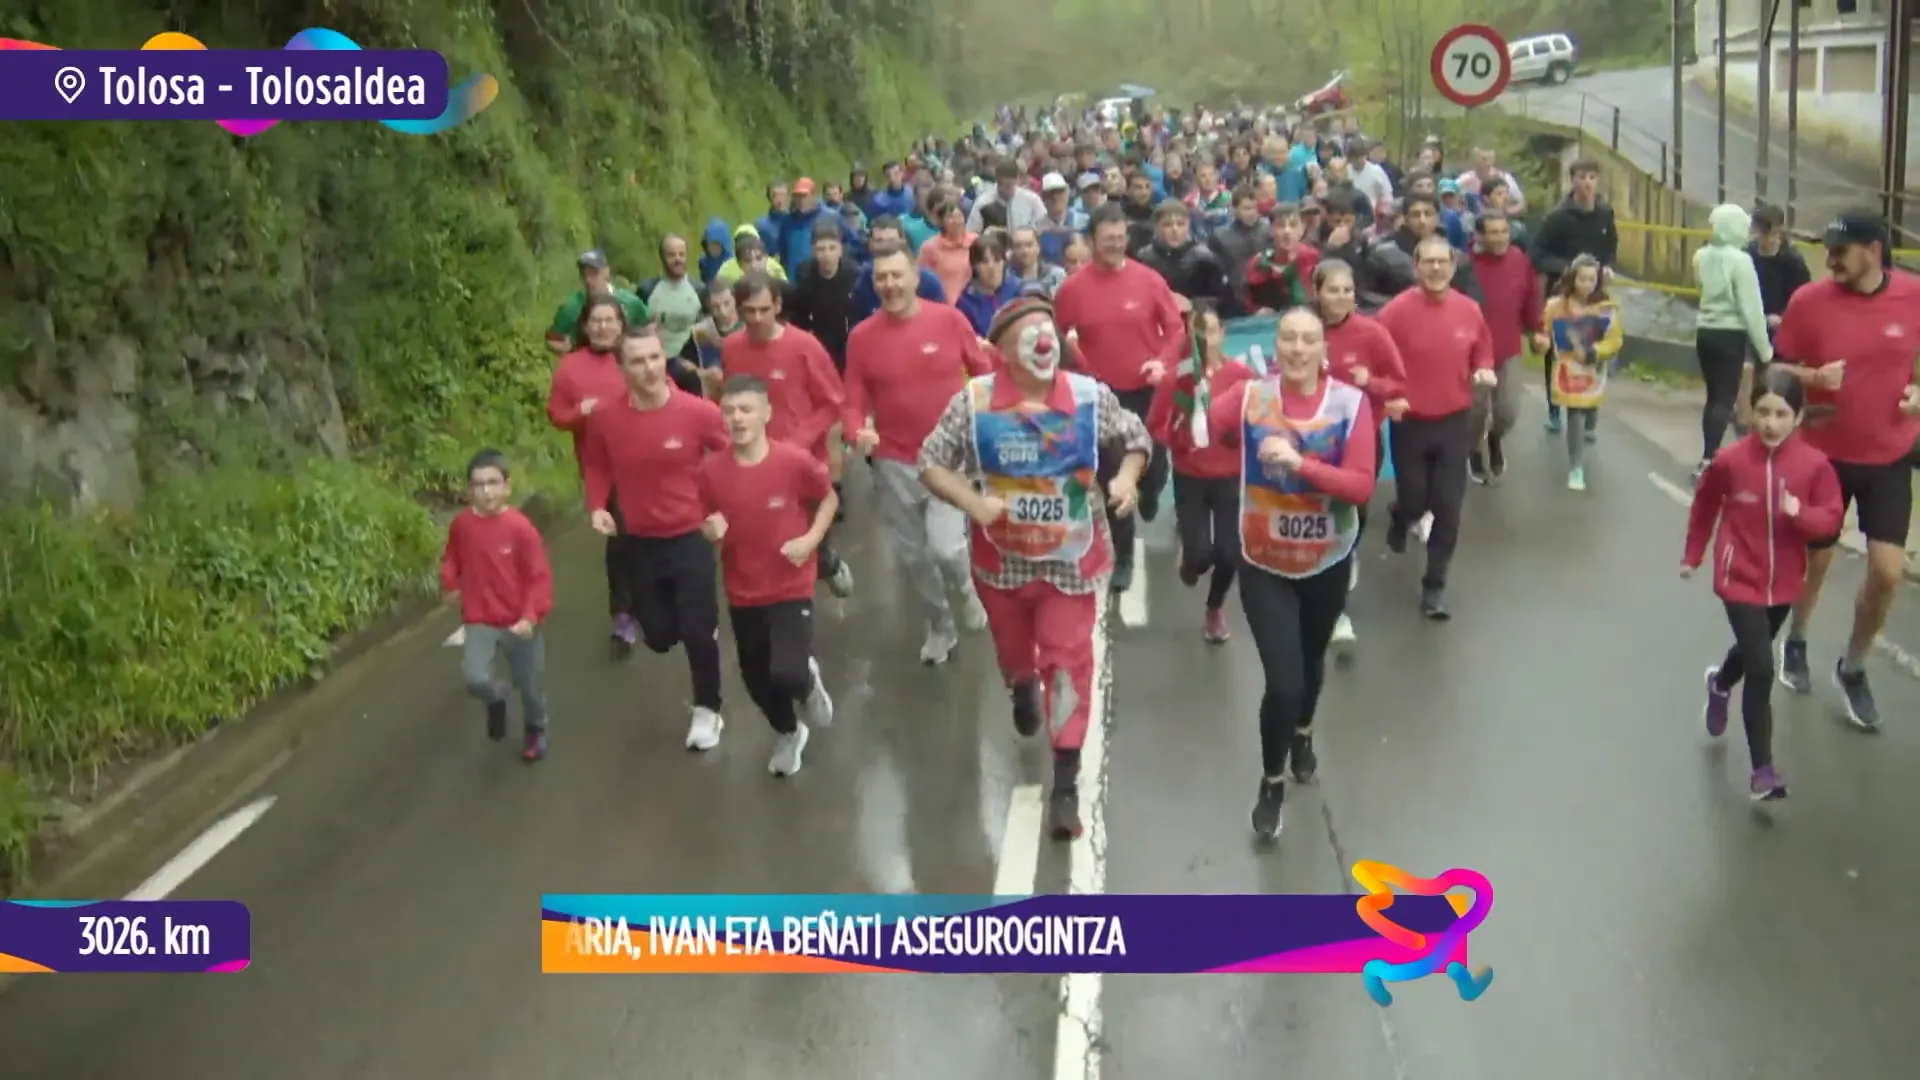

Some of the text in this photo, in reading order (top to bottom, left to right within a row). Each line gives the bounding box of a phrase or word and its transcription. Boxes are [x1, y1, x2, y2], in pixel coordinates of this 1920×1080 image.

[1452, 52, 1491, 79] 70
[1016, 498, 1063, 522] 3025
[1278, 514, 1329, 540] 3025
